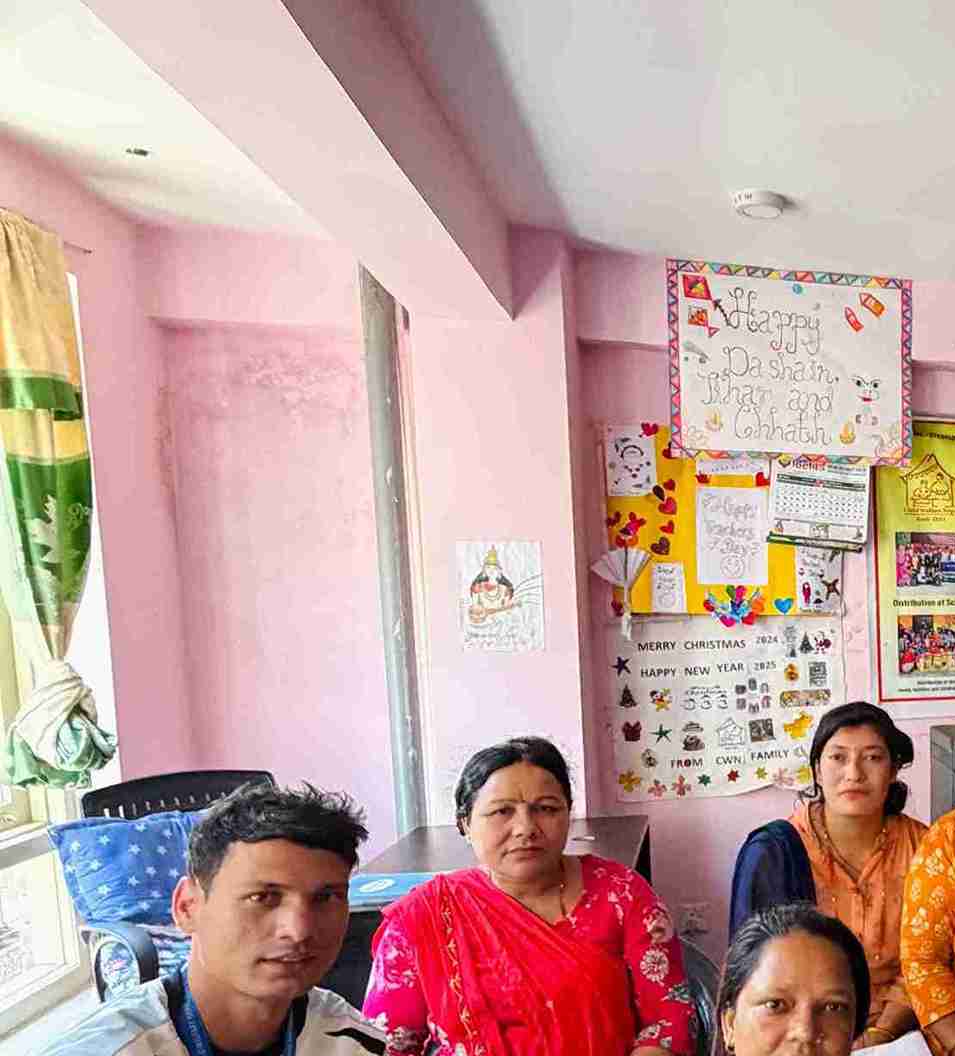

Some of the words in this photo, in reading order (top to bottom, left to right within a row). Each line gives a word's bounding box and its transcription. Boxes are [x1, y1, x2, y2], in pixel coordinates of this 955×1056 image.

[727, 286, 822, 356] Happy
[788, 387, 834, 413] and
[734, 404, 833, 446] Chhath
[637, 640, 677, 652] MERRY
[684, 639, 746, 651] CHRISTMAS
[755, 634, 779, 645] 2024
[640, 667, 677, 679] HAPPY
[684, 666, 711, 677] NEW
[717, 662, 744, 673] YEAR
[753, 661, 777, 673] 2025
[671, 757, 704, 769] FROM
[716, 755, 741, 766] CWN
[751, 749, 790, 761] FAMILY
